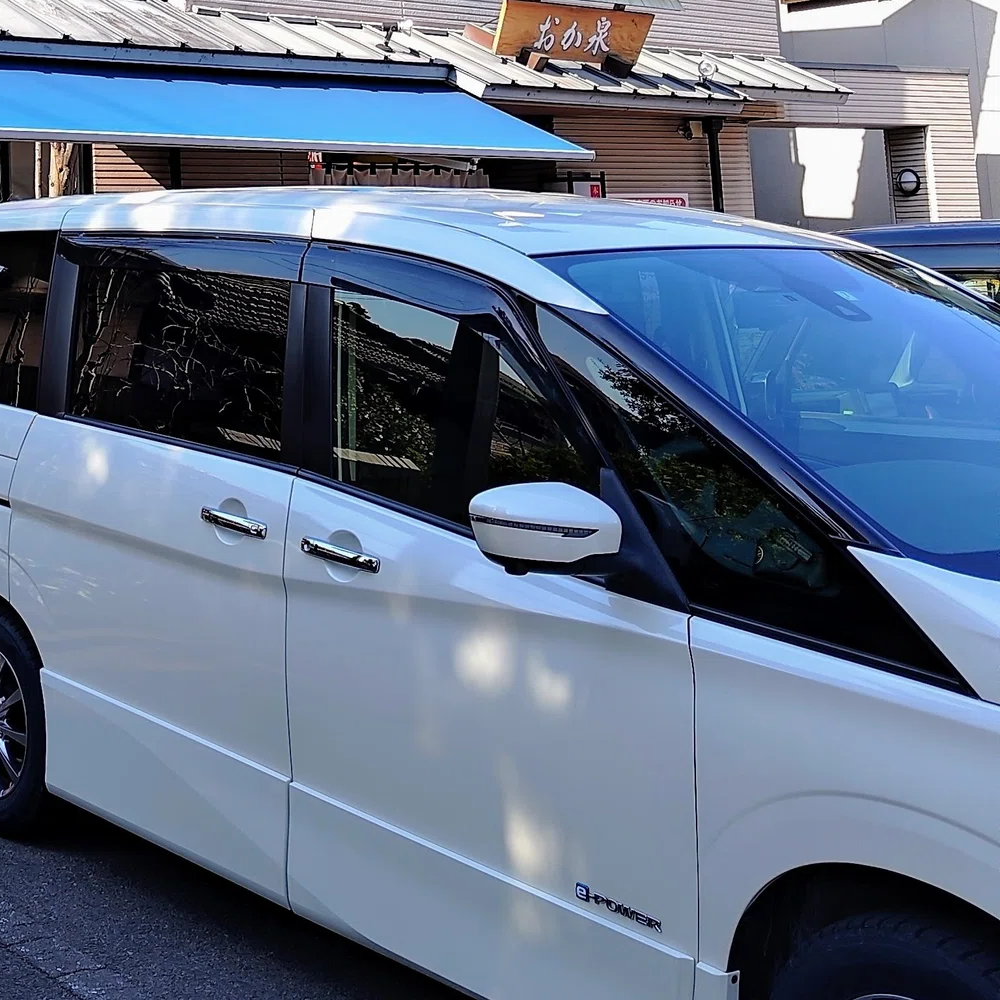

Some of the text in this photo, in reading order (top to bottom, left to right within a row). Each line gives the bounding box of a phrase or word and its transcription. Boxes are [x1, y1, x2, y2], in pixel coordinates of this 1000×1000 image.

[533, 14, 613, 55] おか泉
[642, 198, 686, 207] のお知らせ
[575, 882, 663, 933] e-POWER
